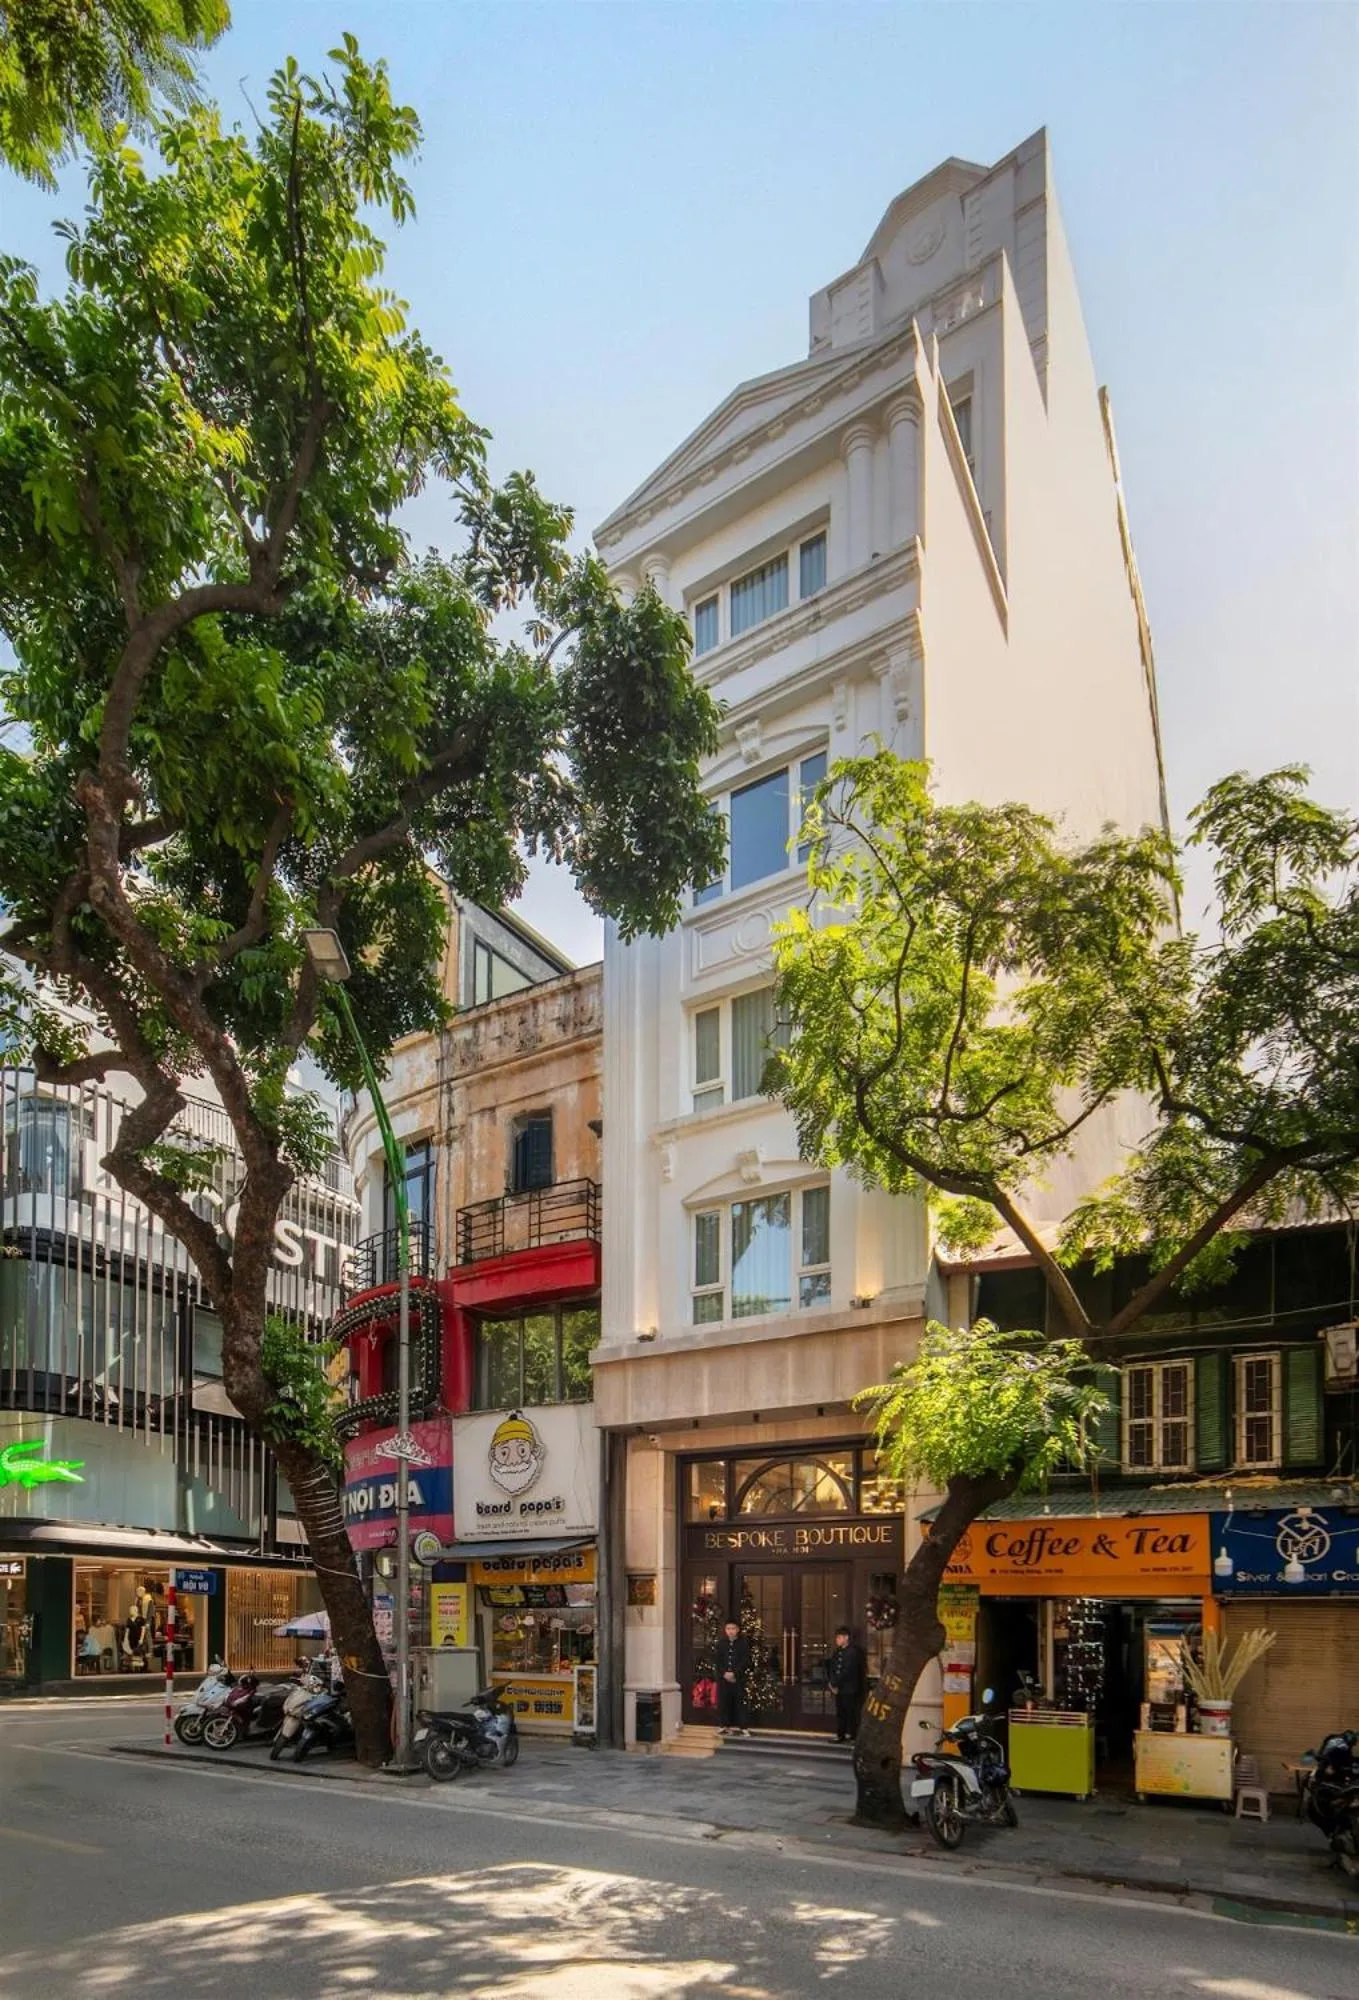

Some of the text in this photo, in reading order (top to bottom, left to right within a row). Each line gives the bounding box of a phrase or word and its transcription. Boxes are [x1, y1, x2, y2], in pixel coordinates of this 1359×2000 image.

[348, 1484, 374, 1520] NỘI
[476, 1500, 512, 1515] beard
[705, 1526, 893, 1549] BESPOKE BOUTIQUE
[985, 1527, 1197, 1566] Coffee & Tea
